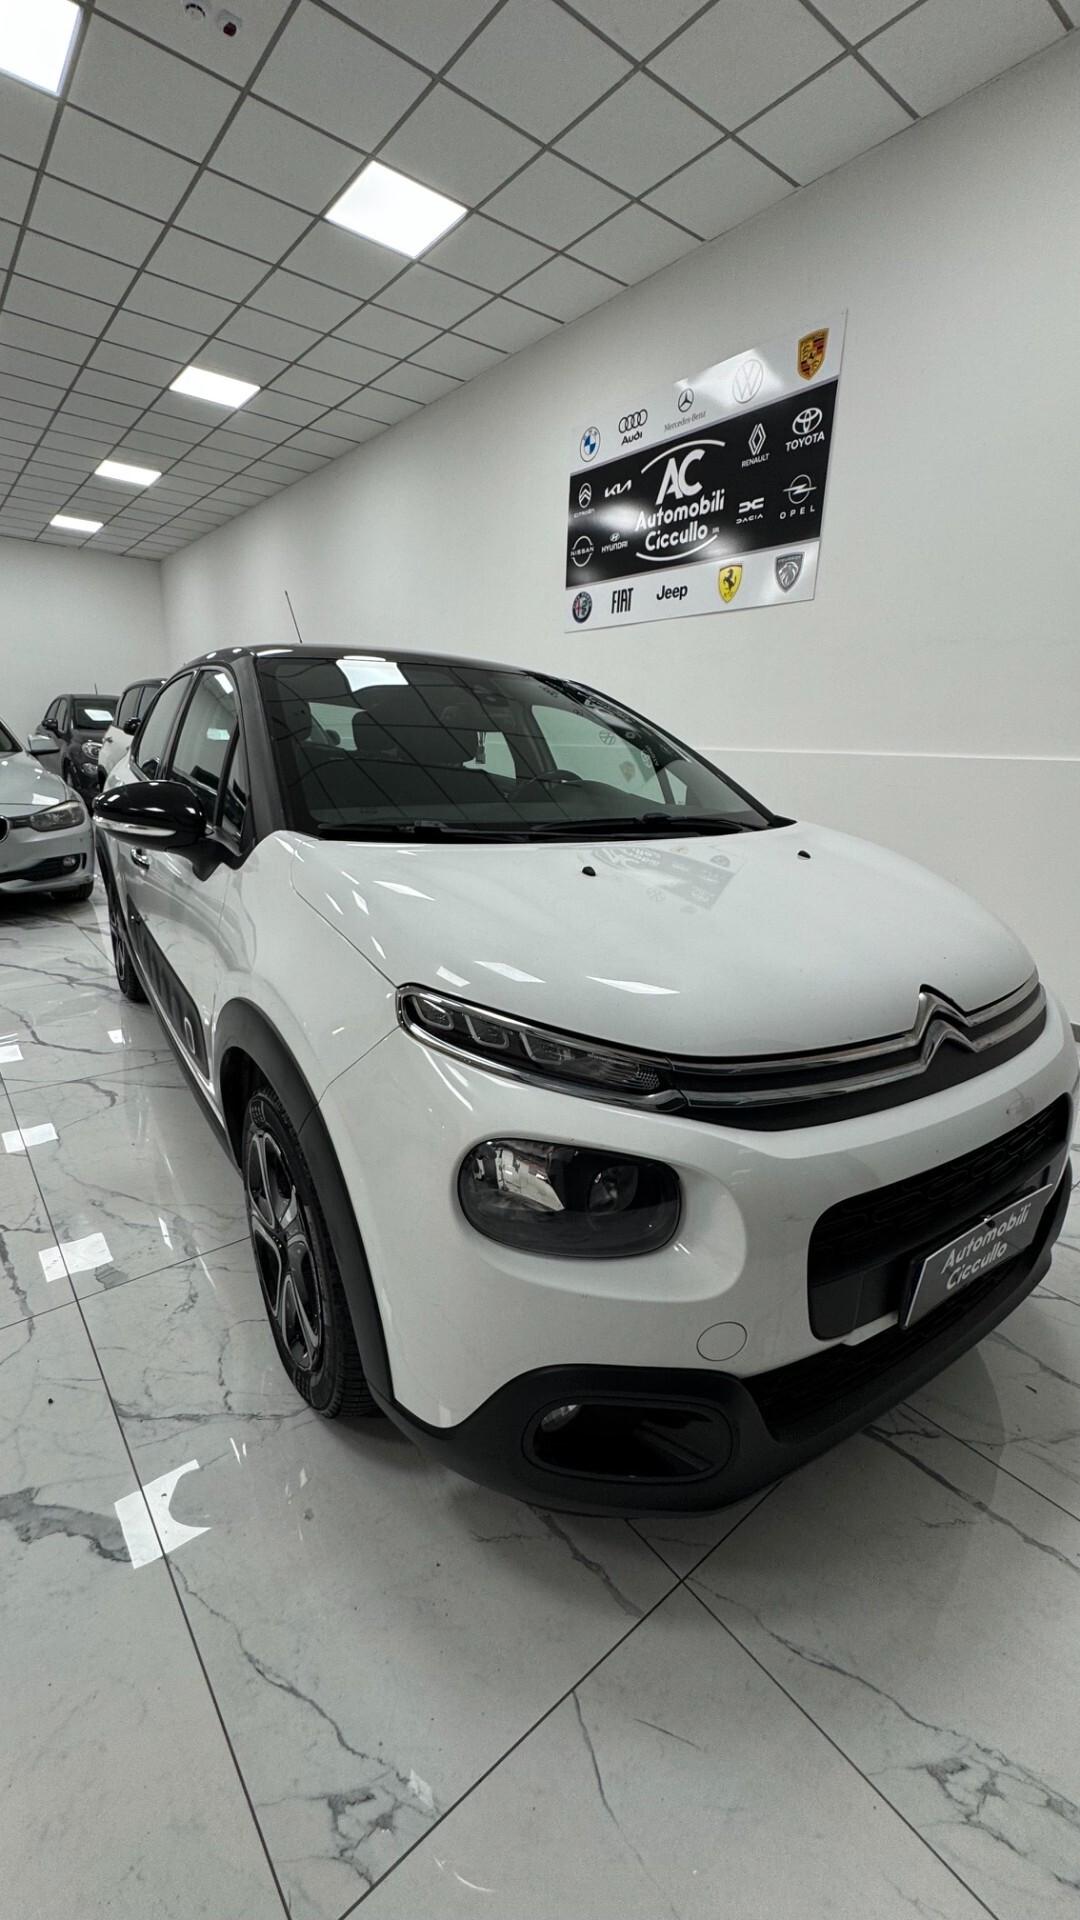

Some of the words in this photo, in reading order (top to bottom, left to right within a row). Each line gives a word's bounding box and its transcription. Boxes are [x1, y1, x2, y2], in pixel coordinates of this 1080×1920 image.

[621, 430, 643, 446] Audi
[785, 431, 825, 452] TOYOTA
[741, 453, 770, 468] RENAULT
[655, 448, 706, 505] AC
[634, 488, 725, 532] Automobili
[735, 514, 764, 525] DACIA
[779, 505, 815, 520] OPEL
[645, 520, 708, 551] Ciccullo
[611, 587, 634, 614] FIAT
[656, 585, 688, 601] Jeep
[940, 1203, 1032, 1274] Automobili
[946, 1241, 1008, 1290] Ciccullo
